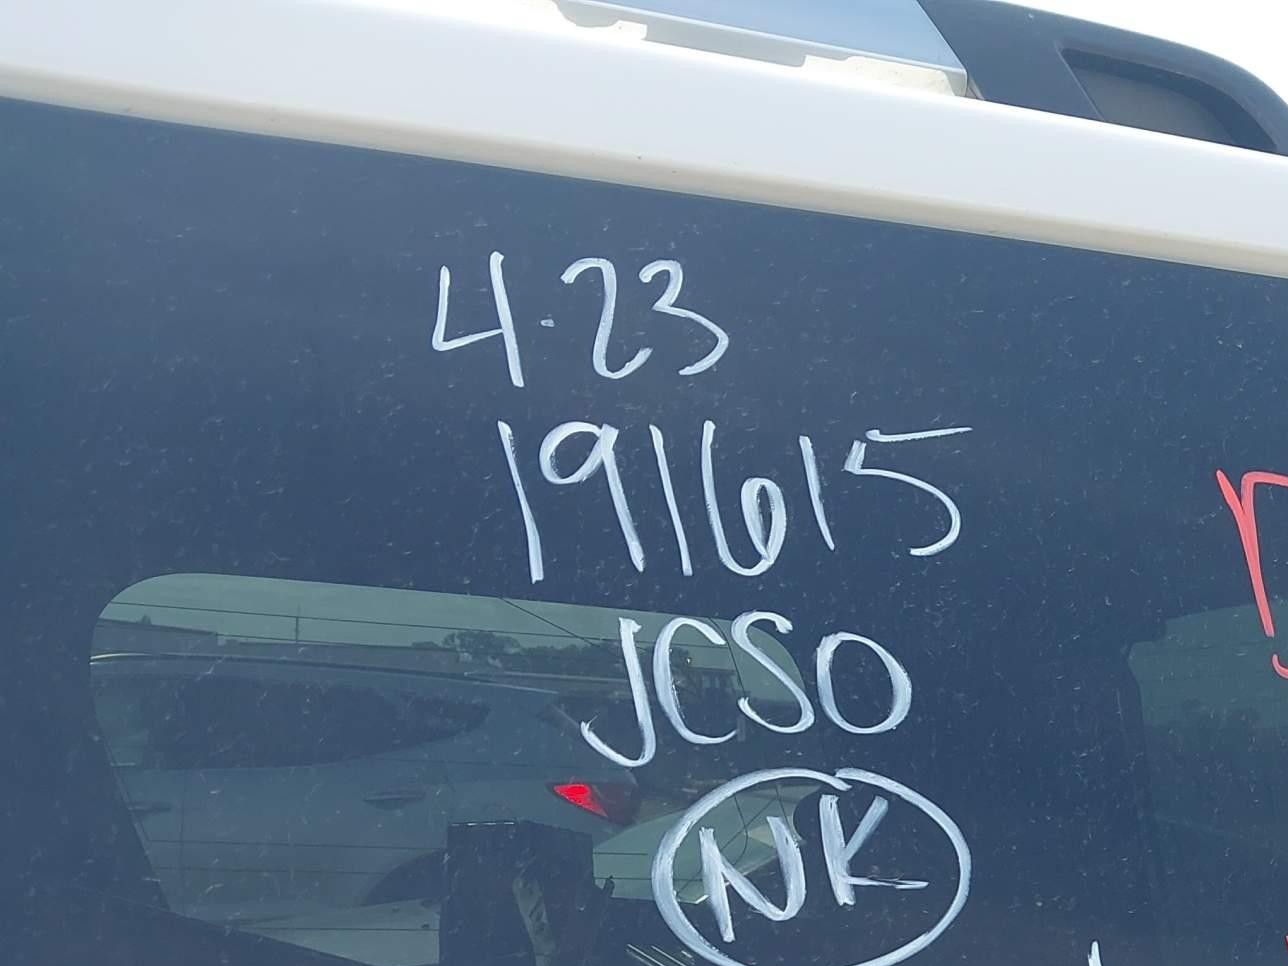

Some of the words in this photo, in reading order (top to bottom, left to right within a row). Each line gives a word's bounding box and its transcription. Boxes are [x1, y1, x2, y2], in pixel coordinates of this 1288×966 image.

[497, 419, 973, 583] 191615
[580, 611, 912, 767] JCSO
[698, 794, 929, 943] NK
